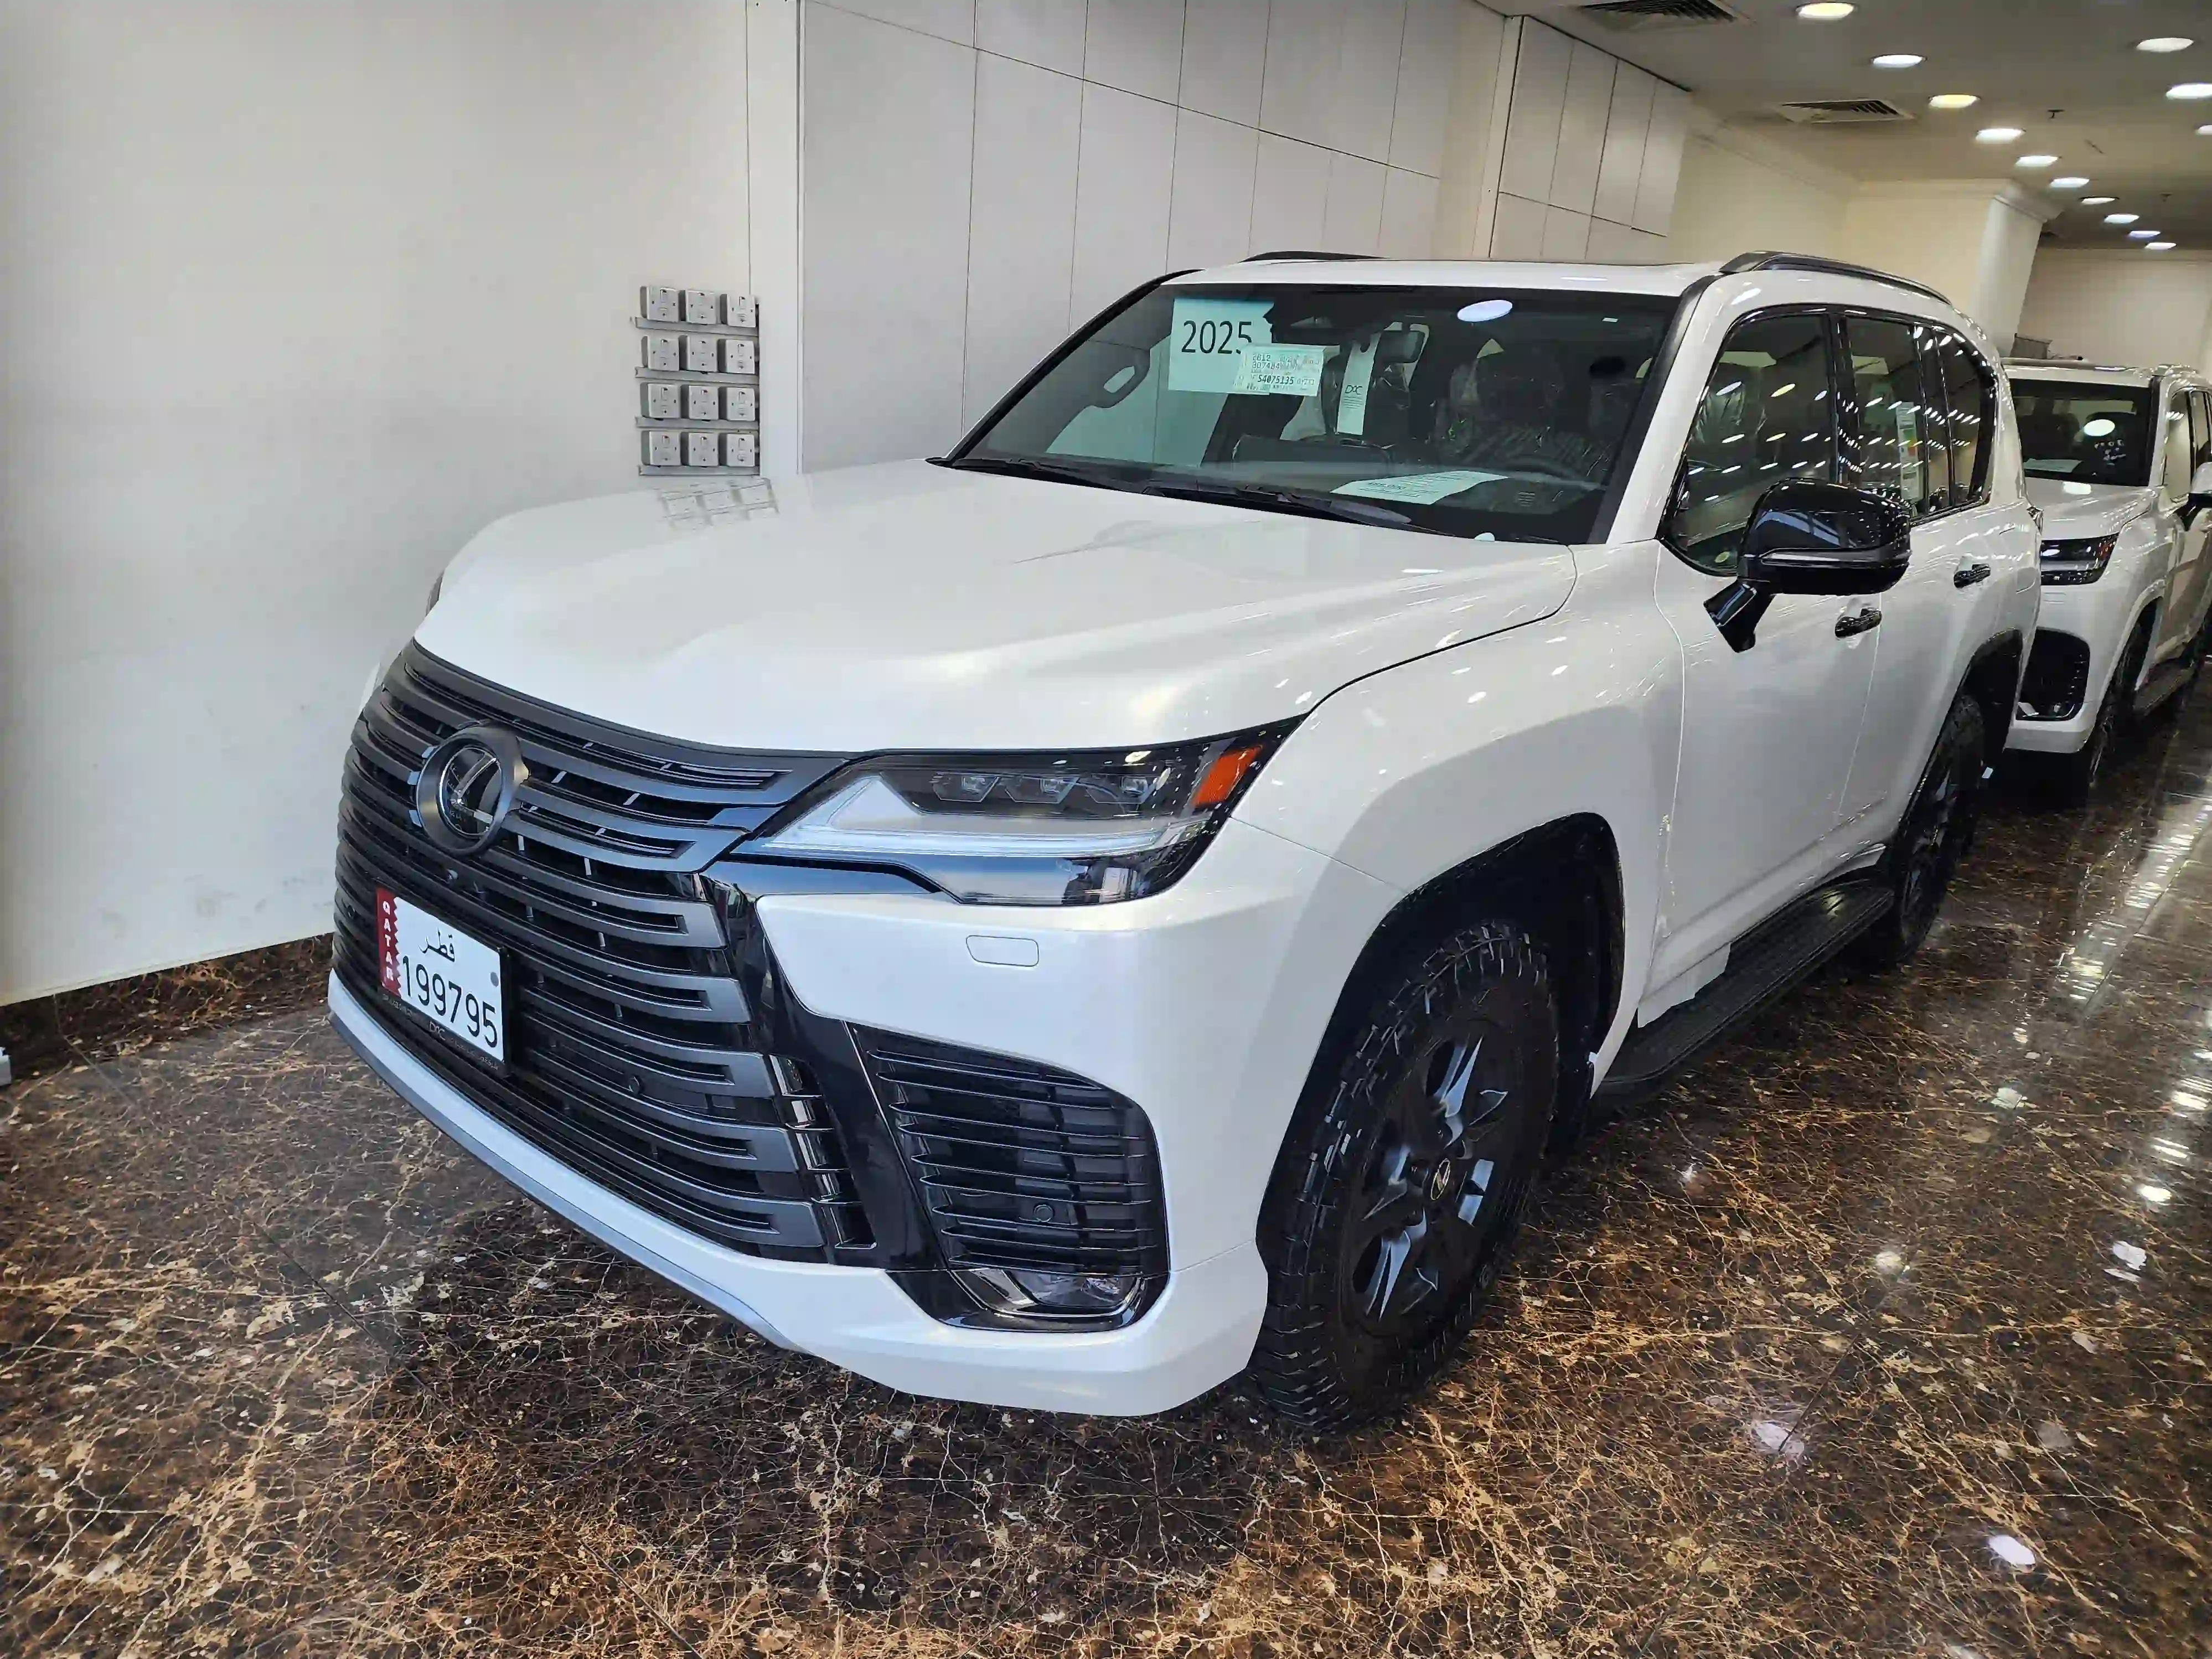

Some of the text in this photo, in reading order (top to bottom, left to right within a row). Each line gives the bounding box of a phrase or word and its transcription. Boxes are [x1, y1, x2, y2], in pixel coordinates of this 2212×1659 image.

[1181, 320, 1252, 355] 2025
[383, 900, 394, 981] QATAR
[418, 927, 455, 962] قطر
[402, 955, 498, 1048] 199795
